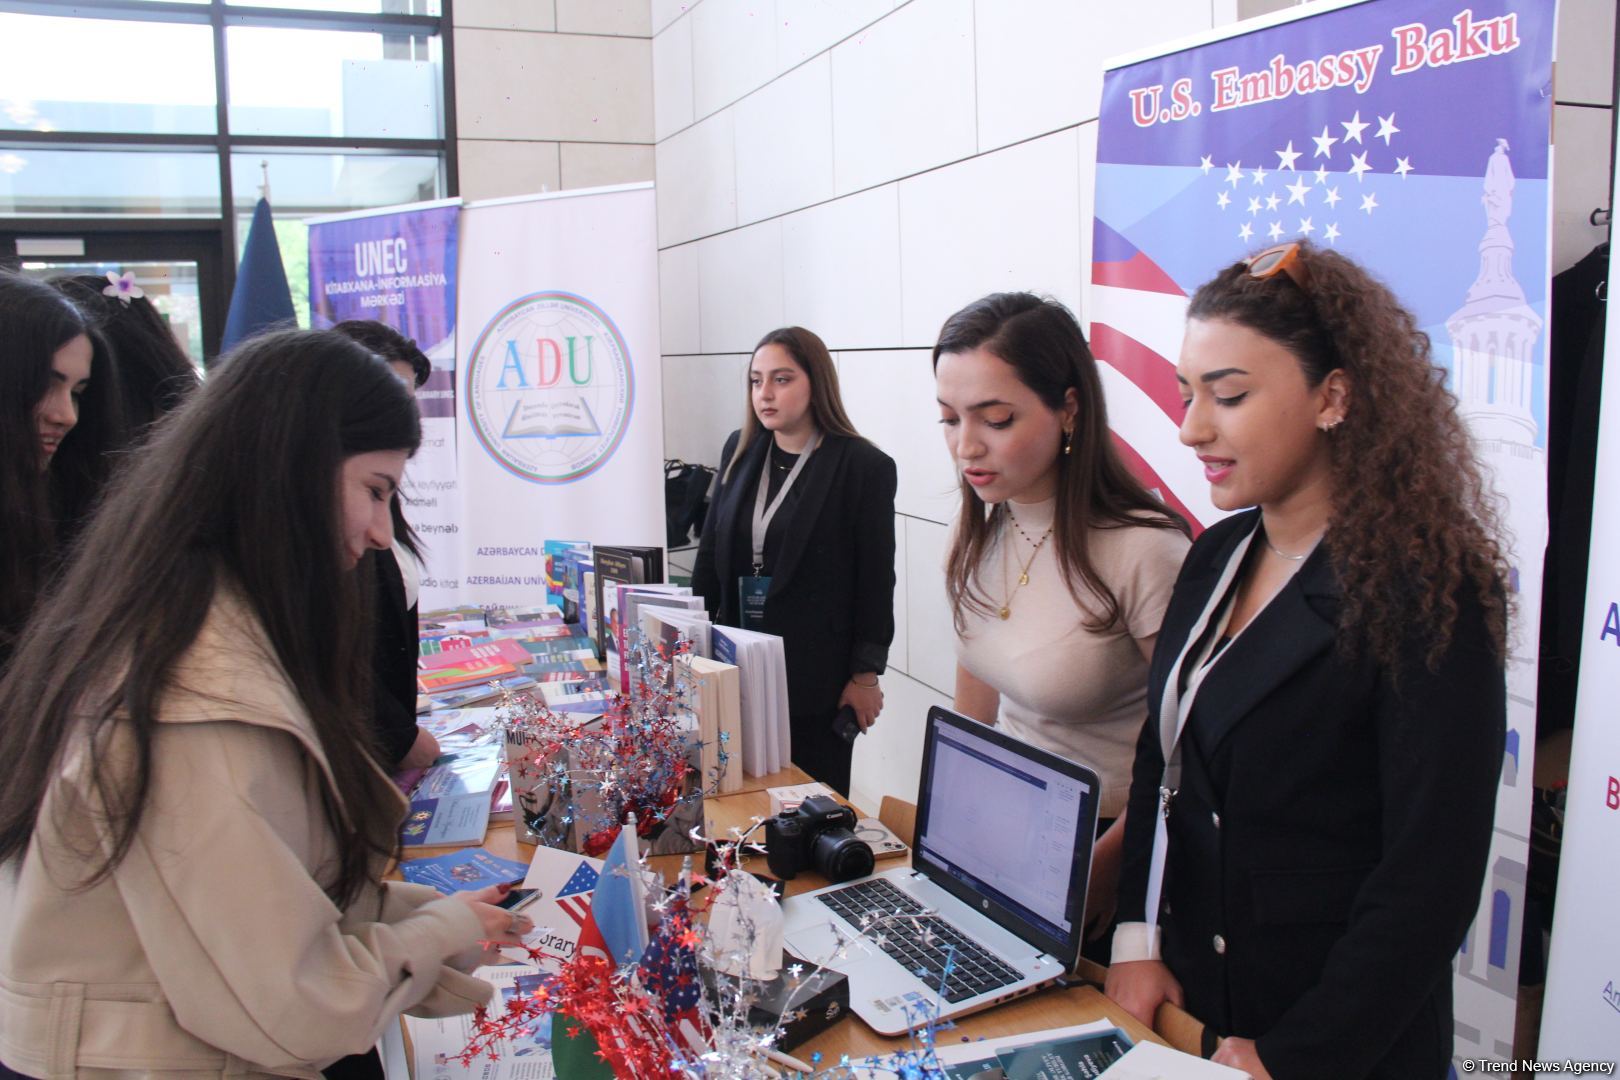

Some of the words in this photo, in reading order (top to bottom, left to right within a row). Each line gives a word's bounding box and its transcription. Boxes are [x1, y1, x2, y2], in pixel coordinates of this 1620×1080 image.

[1129, 79, 1201, 127] U.S.
[1211, 44, 1383, 112] Embassy
[1392, 9, 1520, 75] Baku
[354, 237, 408, 277] UNEC
[496, 335, 593, 388] ADU
[477, 546, 539, 556] AZƏRBAYCAN
